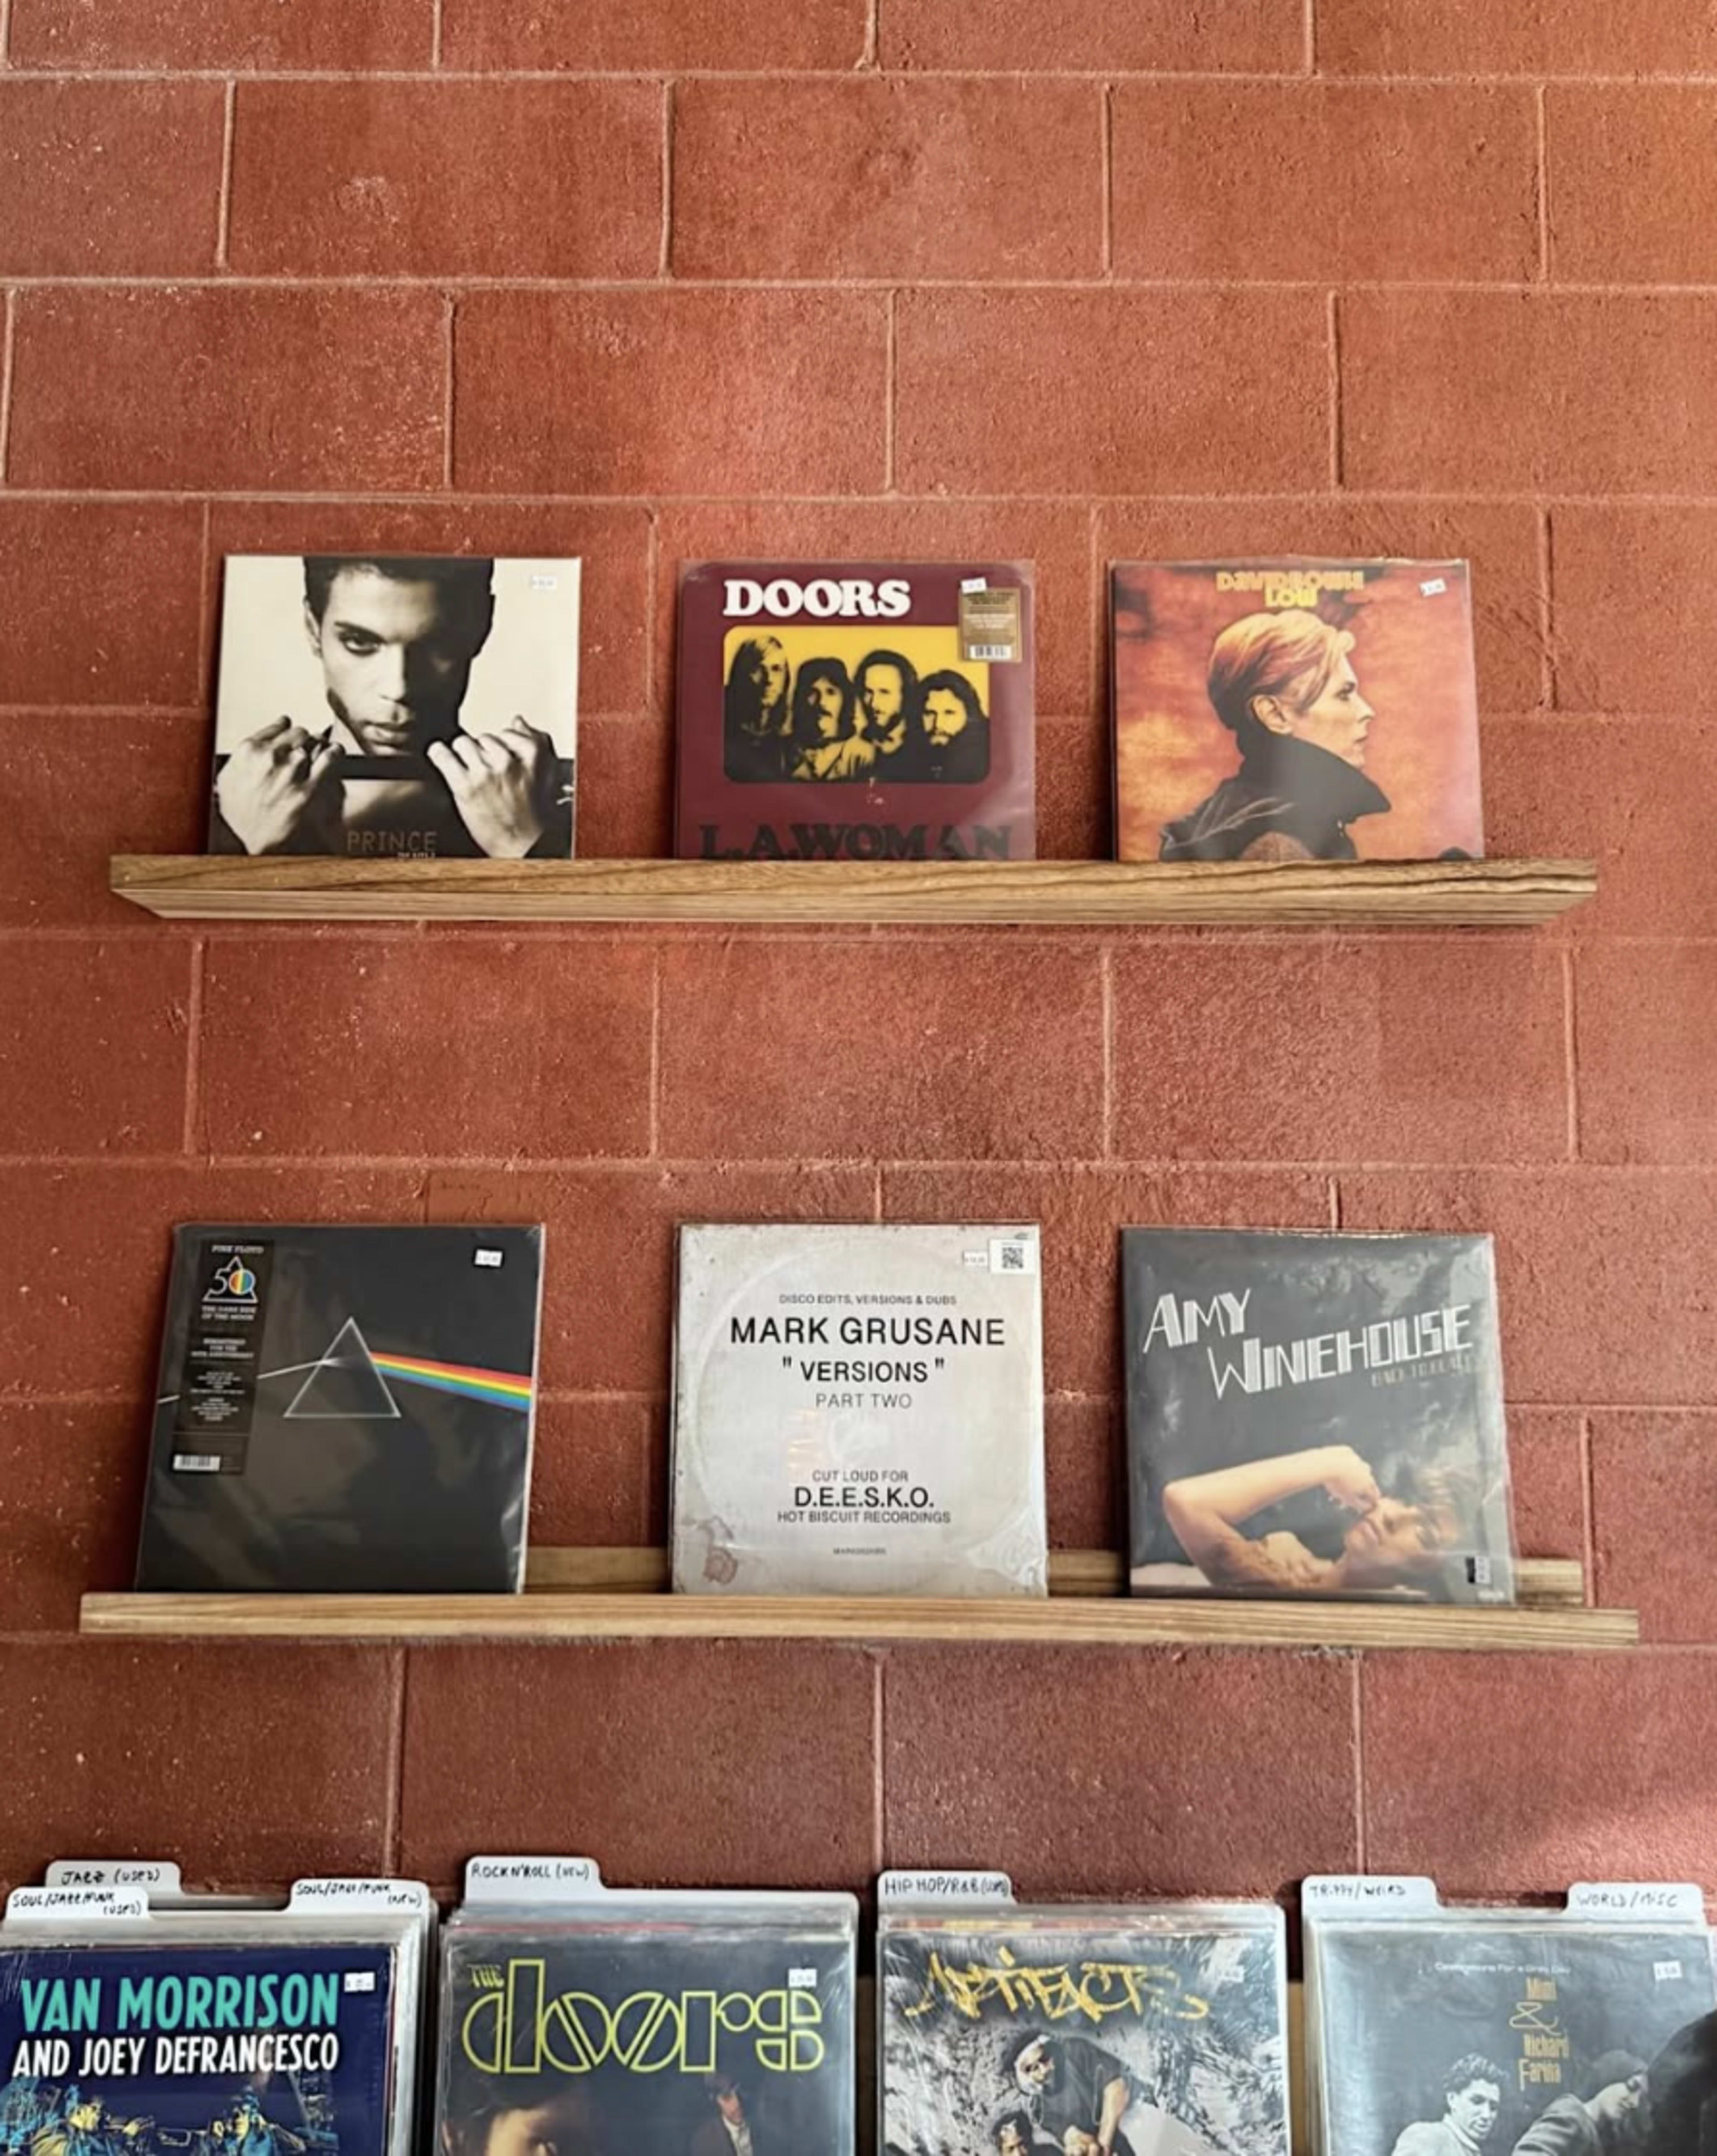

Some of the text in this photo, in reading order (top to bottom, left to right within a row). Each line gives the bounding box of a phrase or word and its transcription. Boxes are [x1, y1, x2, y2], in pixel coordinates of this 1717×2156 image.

[723, 579, 911, 617] DOORS
[348, 831, 437, 852] PRINCE
[779, 1294, 815, 1304] DISCO
[856, 1295, 913, 1304] VERSIONS
[915, 1295, 923, 1304] &
[926, 1295, 957, 1305] DUBS
[731, 1316, 1005, 1345] MARK GRUSANE
[1143, 1288, 1251, 1353] AMY
[1207, 1304, 1473, 1399] WINEHOUSE
[816, 1393, 913, 1409] PART TWO
[812, 1470, 909, 1482] CUT LOUD FOR
[795, 1486, 935, 1508] D.E.E.S.K.O.
[777, 1511, 952, 1524] HOT BISCUIT RECORDINGS
[885, 1877, 913, 1895] HIP
[467, 1964, 505, 1988] THE
[21, 1973, 339, 2032] VAN MORRISON
[1509, 2001, 1562, 2035] &
[12, 2033, 339, 2077] AND JOEY DEFRANCESCO
